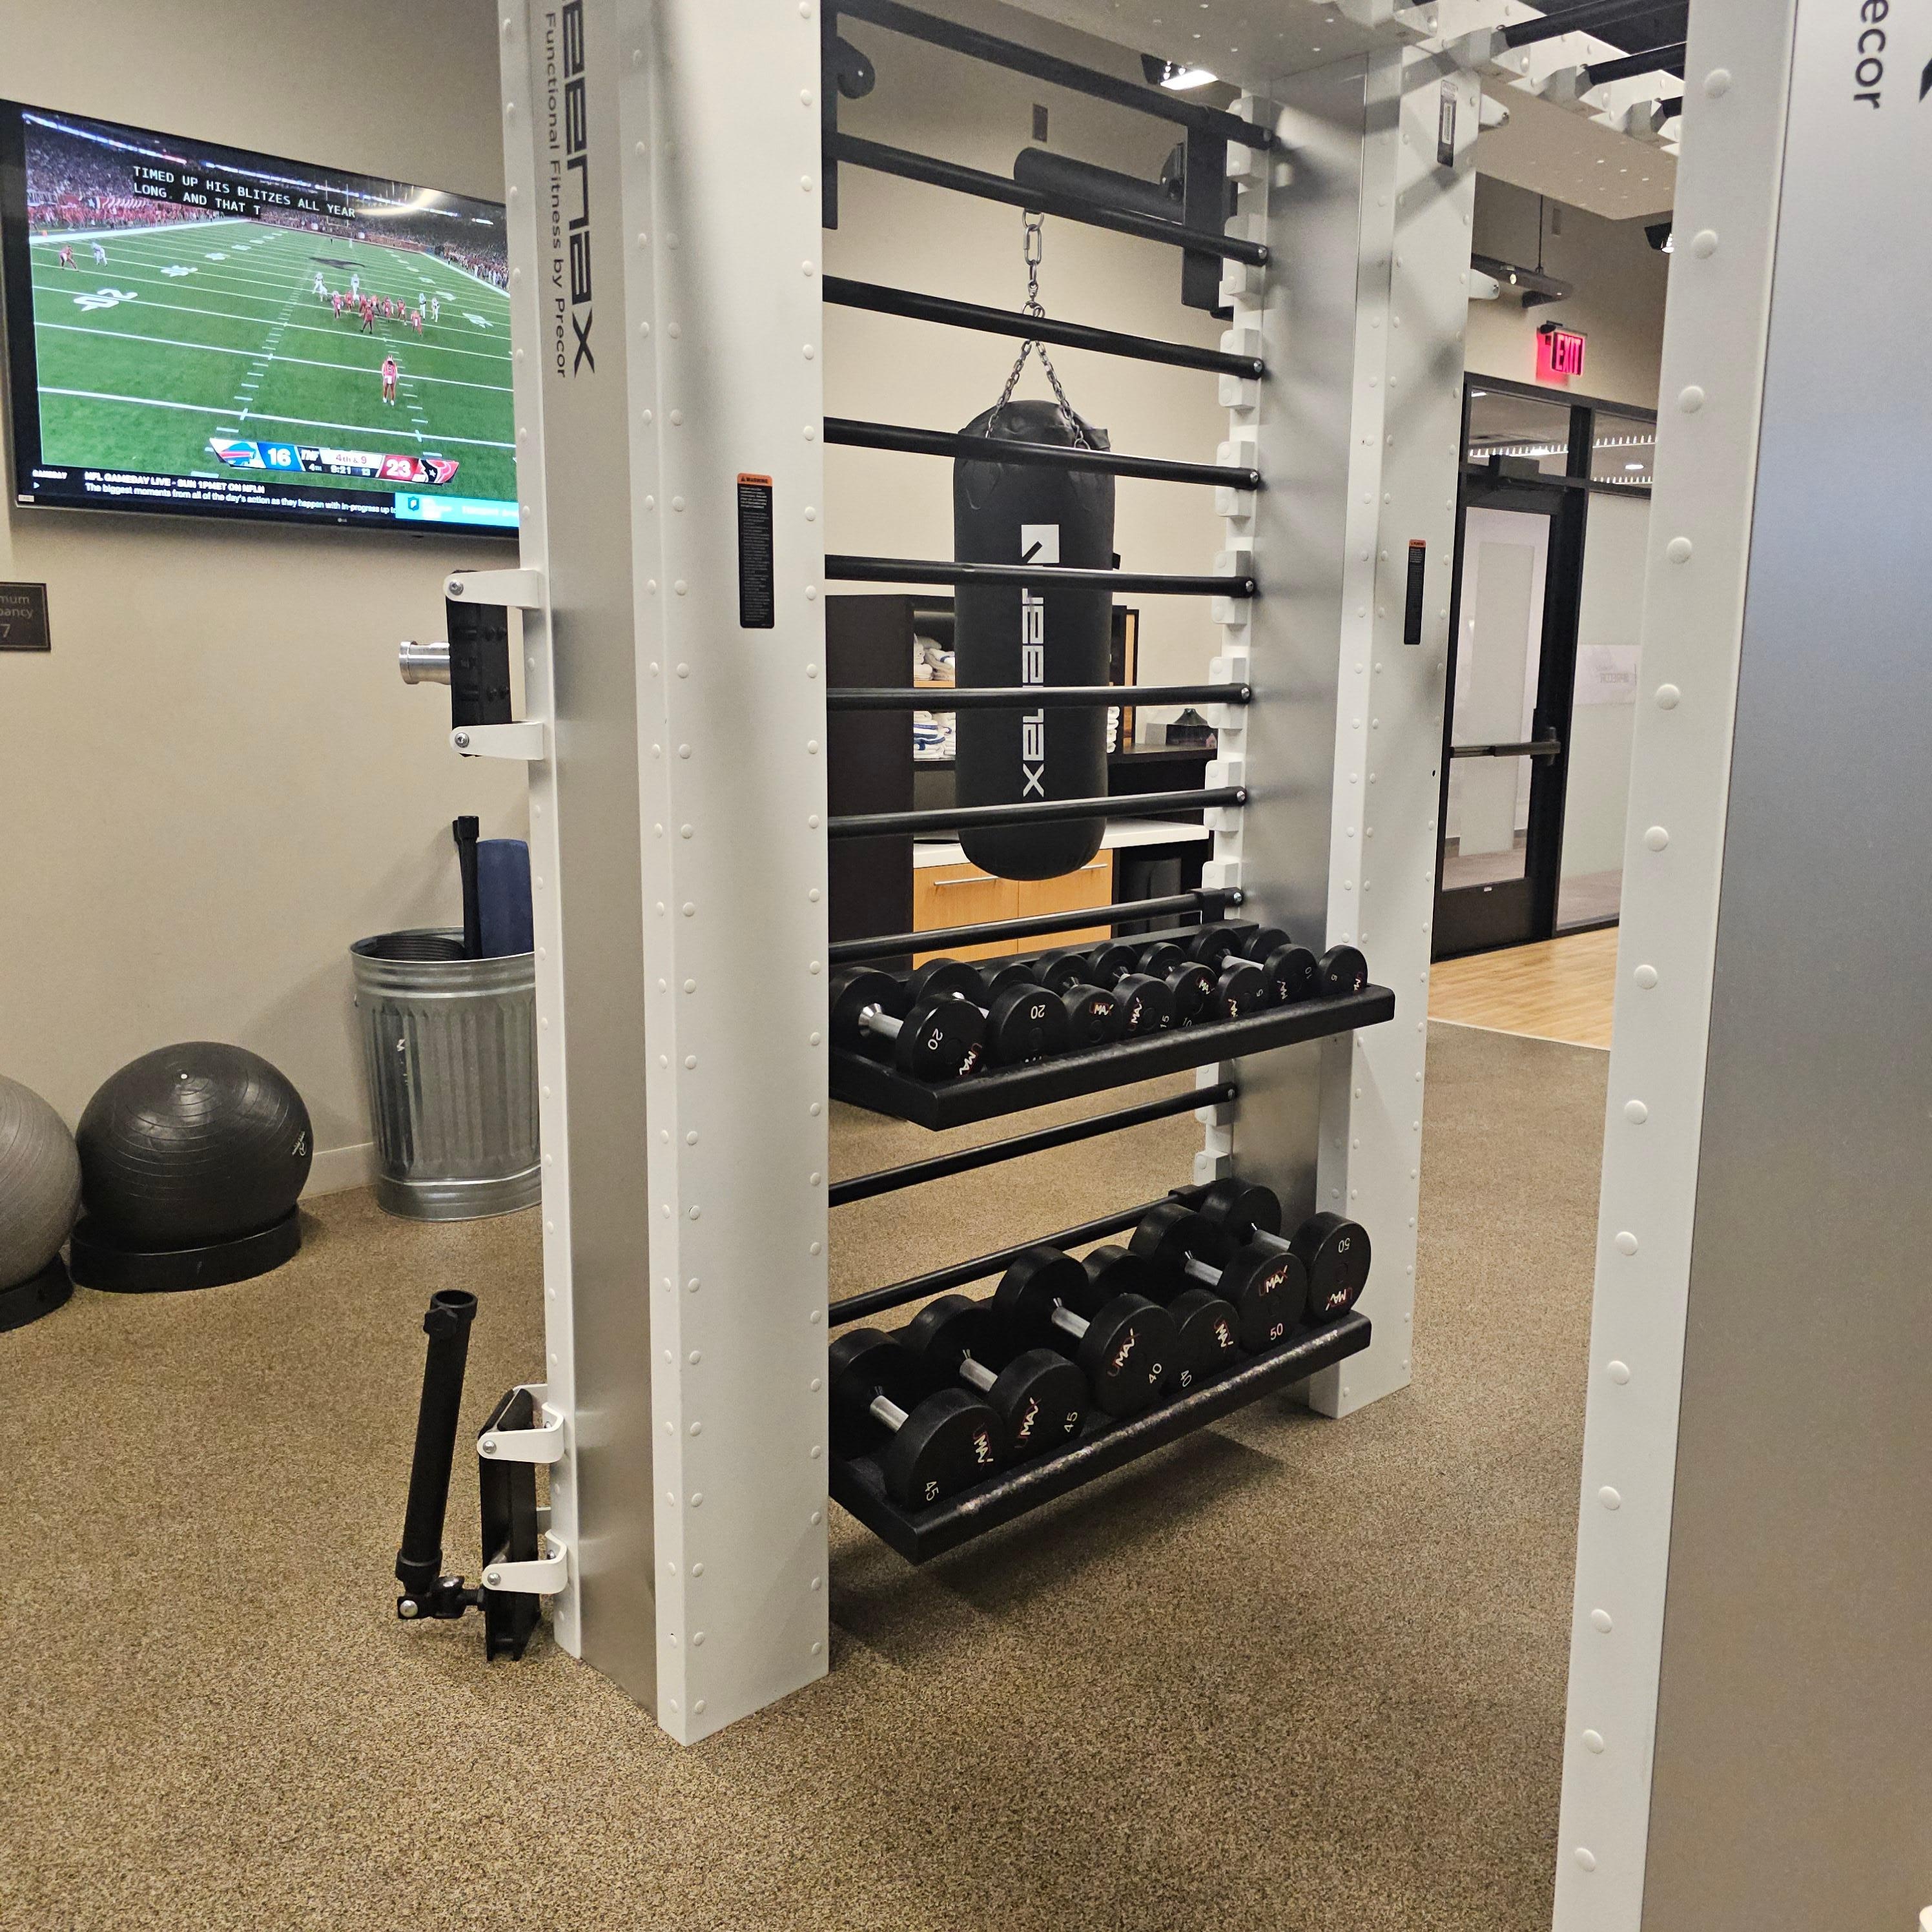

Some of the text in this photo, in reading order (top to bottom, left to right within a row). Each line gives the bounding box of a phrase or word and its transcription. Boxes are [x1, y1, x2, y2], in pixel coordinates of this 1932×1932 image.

[1853, 0, 1889, 109] ecor
[133, 166, 356, 218] TIMED UP HIS BLITZES ALL YEAR
[546, 13, 566, 378] Functional Fitness by Precor
[183, 192, 207, 206] AND
[215, 198, 245, 212] THAT
[254, 205, 260, 215] T
[1555, 334, 1581, 373] EXIT
[268, 448, 291, 467] 16
[336, 454, 351, 463] 4th
[362, 456, 367, 464] 9
[385, 458, 411, 477] 23
[85, 471, 103, 482] NFL
[104, 473, 150, 485] GAMEDAY
[150, 477, 171, 487] LIVE
[178, 478, 196, 489] SUN
[228, 483, 242, 493] ON
[85, 482, 101, 493] The
[102, 484, 132, 495] biggest
[134, 488, 170, 497] moments
[172, 488, 191, 498] from
[192, 489, 201, 499] all
[202, 491, 211, 500] of
[212, 492, 225, 502] the
[226, 493, 246, 504] day's
[247, 495, 271, 505] action
[281, 497, 297, 508] they
[298, 498, 324, 509] happen
[325, 500, 340, 510] with
[380, 506, 390, 515] up
[1031, 1004, 1045, 1020] 20
[1160, 1015, 1169, 1029] 15
[928, 1028, 943, 1051] 20
[1338, 1238, 1351, 1253] 50
[1270, 1323, 1284, 1341] 50
[1149, 1363, 1162, 1384] 40
[1180, 1370, 1192, 1388] 40
[1064, 1412, 1078, 1433] 45
[925, 1481, 939, 1501] 45
